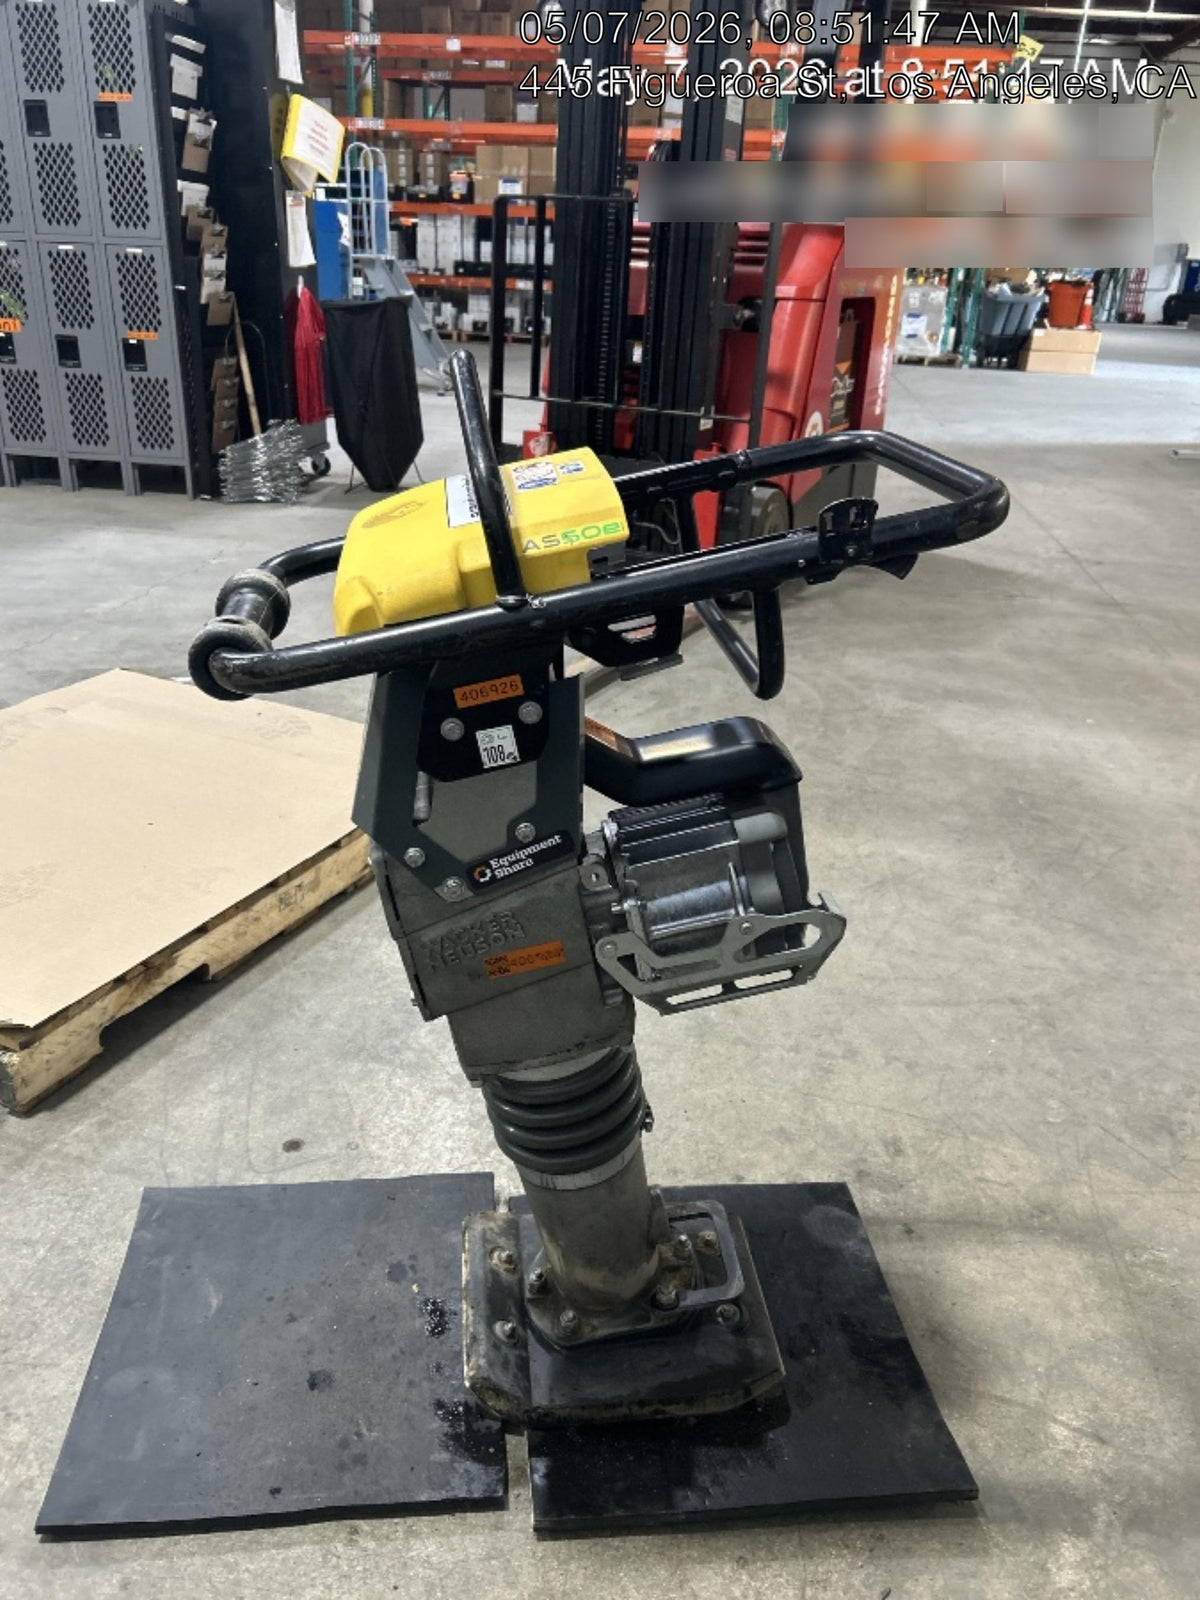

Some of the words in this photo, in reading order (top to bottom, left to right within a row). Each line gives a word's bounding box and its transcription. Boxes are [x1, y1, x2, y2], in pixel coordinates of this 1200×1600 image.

[460, 680, 519, 702] 406926
[483, 744, 505, 764] 108
[490, 834, 562, 869] Equipment
[493, 858, 534, 879] Share
